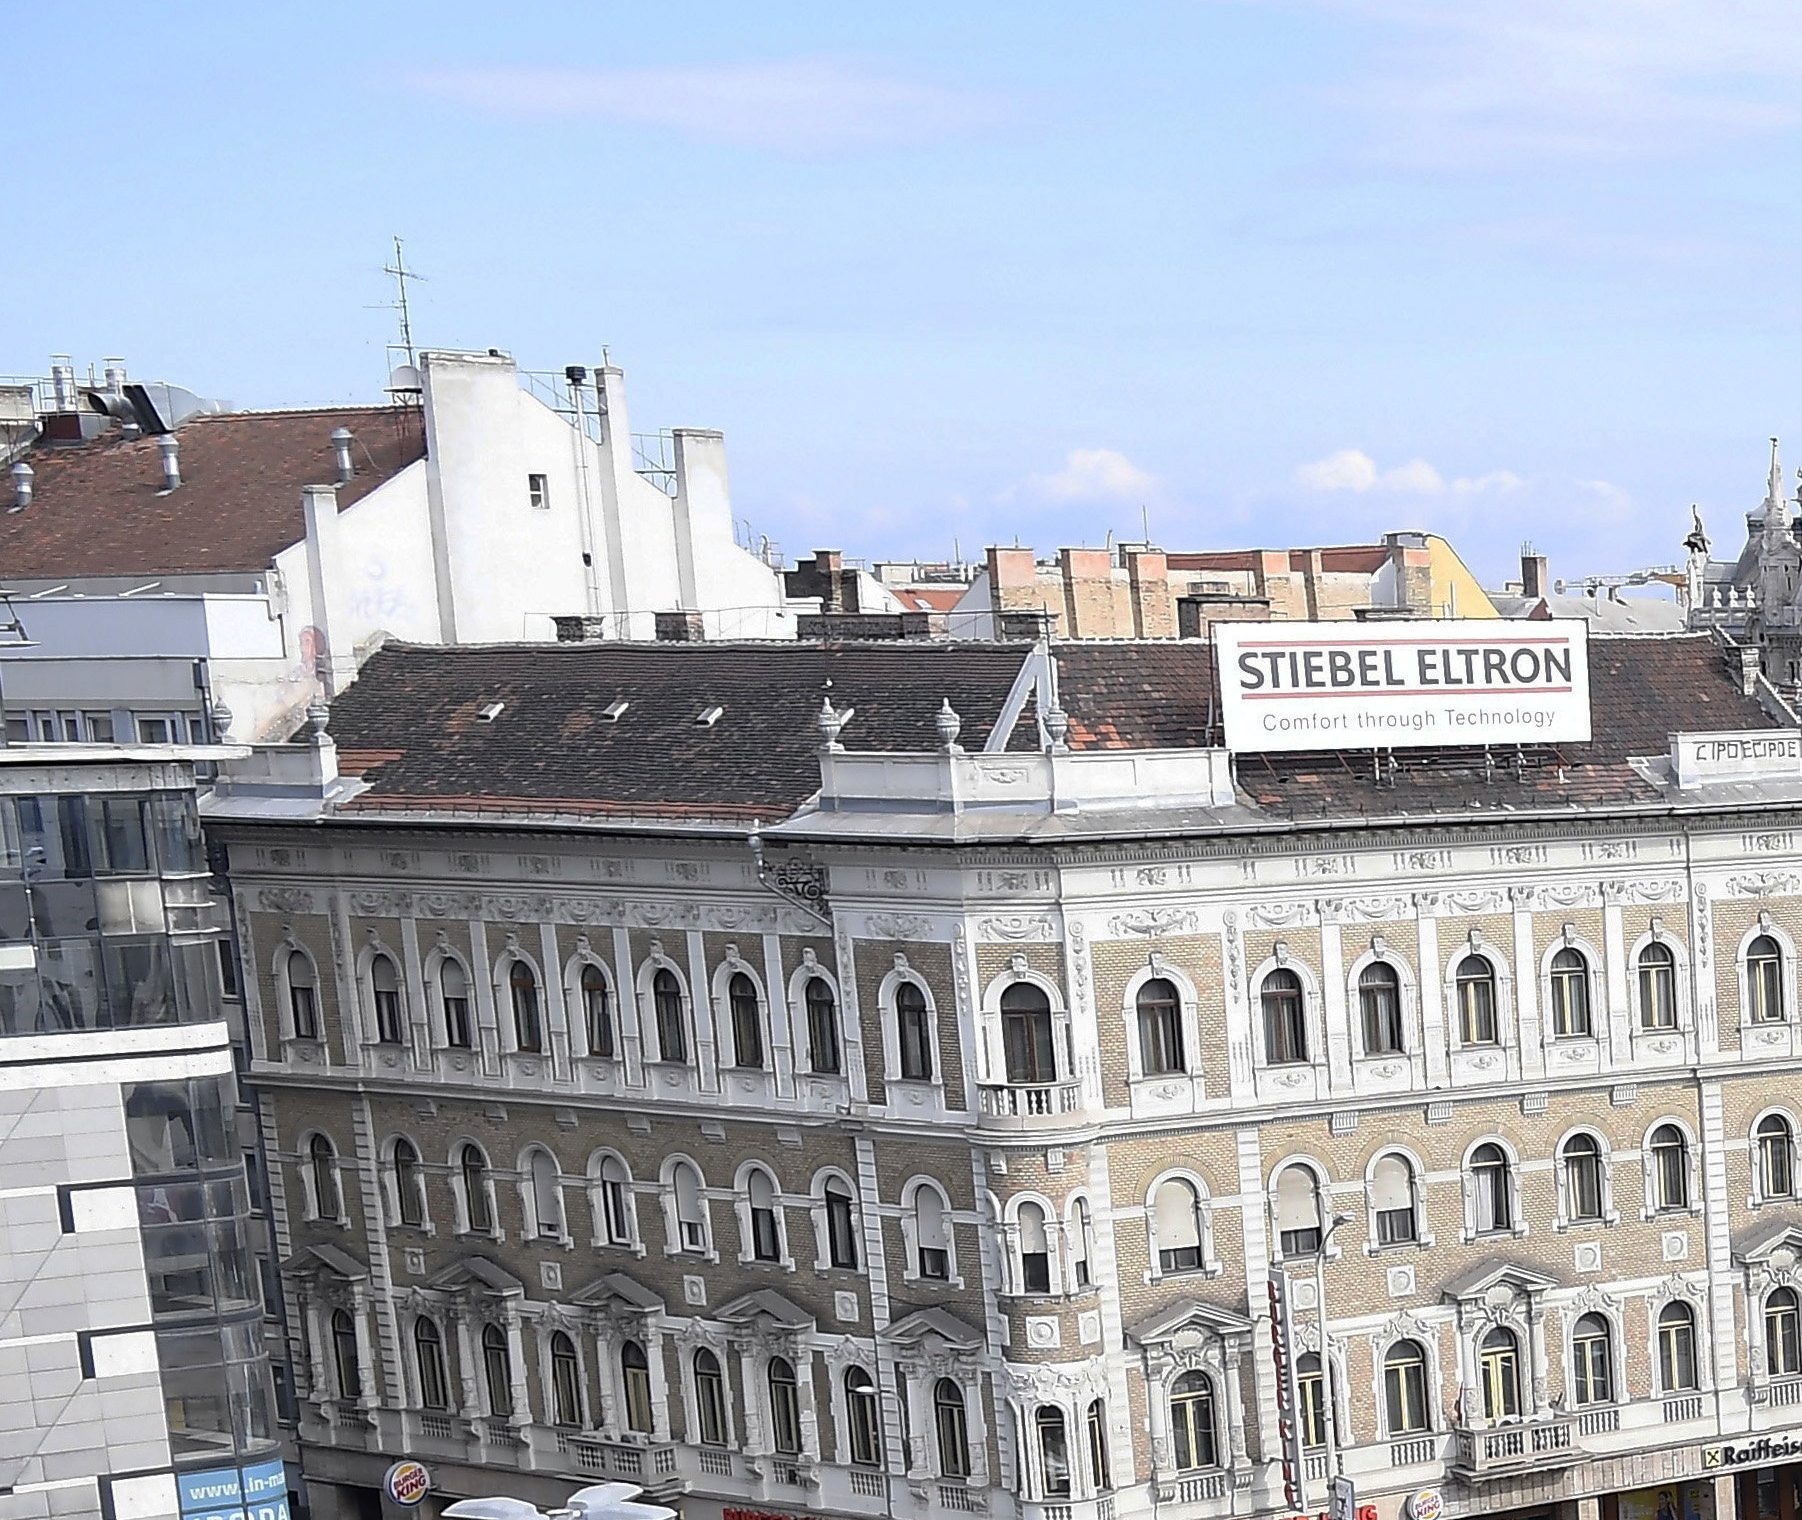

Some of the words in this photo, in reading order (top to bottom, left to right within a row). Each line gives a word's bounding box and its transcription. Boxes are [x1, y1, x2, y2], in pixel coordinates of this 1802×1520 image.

[1237, 649, 1405, 689] STIEBEL
[1417, 648, 1573, 685] ELTRON
[1263, 713, 1348, 732] Comfort
[1358, 710, 1436, 731] through
[1445, 709, 1556, 729] Technology
[393, 1467, 423, 1490] BURGER
[396, 1474, 427, 1500] KING
[1416, 1500, 1441, 1519] KING
